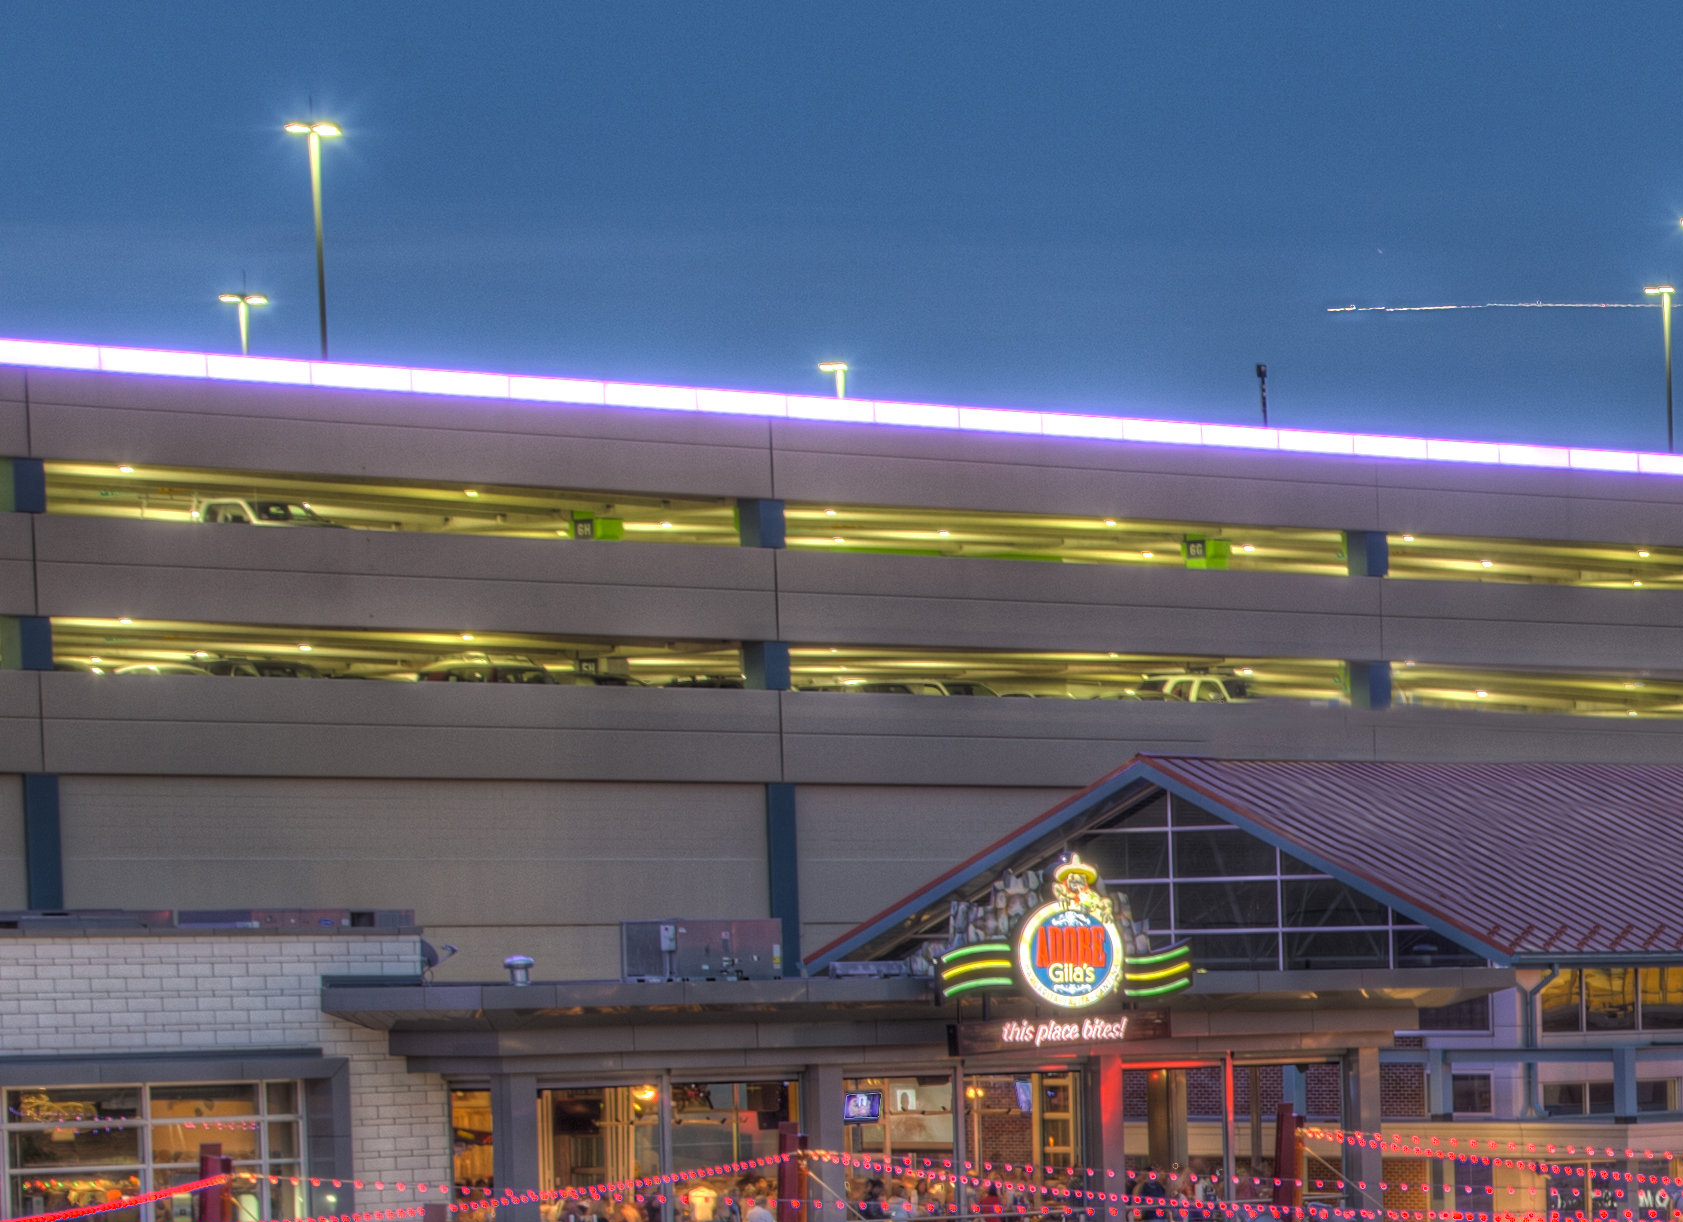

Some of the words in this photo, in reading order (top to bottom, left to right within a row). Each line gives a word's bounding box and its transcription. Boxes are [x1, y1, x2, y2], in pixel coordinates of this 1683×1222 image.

[1036, 926, 1106, 968] ADOBE
[1049, 963, 1095, 985] Gila's
[1002, 1020, 1035, 1042] this
[1035, 1018, 1080, 1046] place
[1081, 1016, 1128, 1040] bites!
